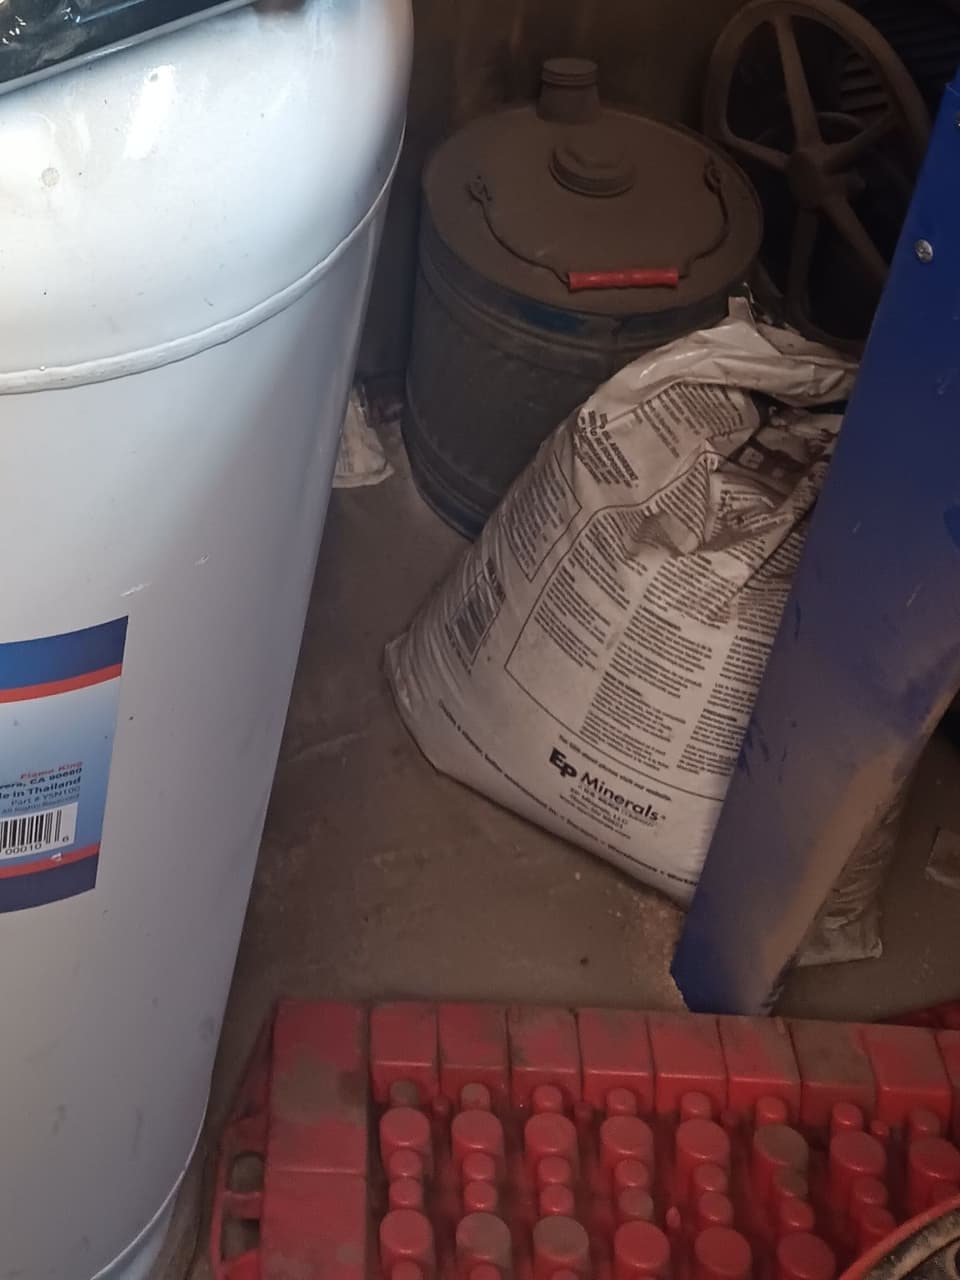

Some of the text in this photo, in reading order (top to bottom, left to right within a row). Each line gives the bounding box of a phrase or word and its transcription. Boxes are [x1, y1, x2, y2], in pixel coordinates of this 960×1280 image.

[12, 790, 25, 799] in
[26, 775, 81, 795] Thailand
[30, 777, 46, 785] CA
[11, 796, 32, 807] Part
[580, 772, 659, 822] Minerals
[4, 842, 42, 855] 00010
